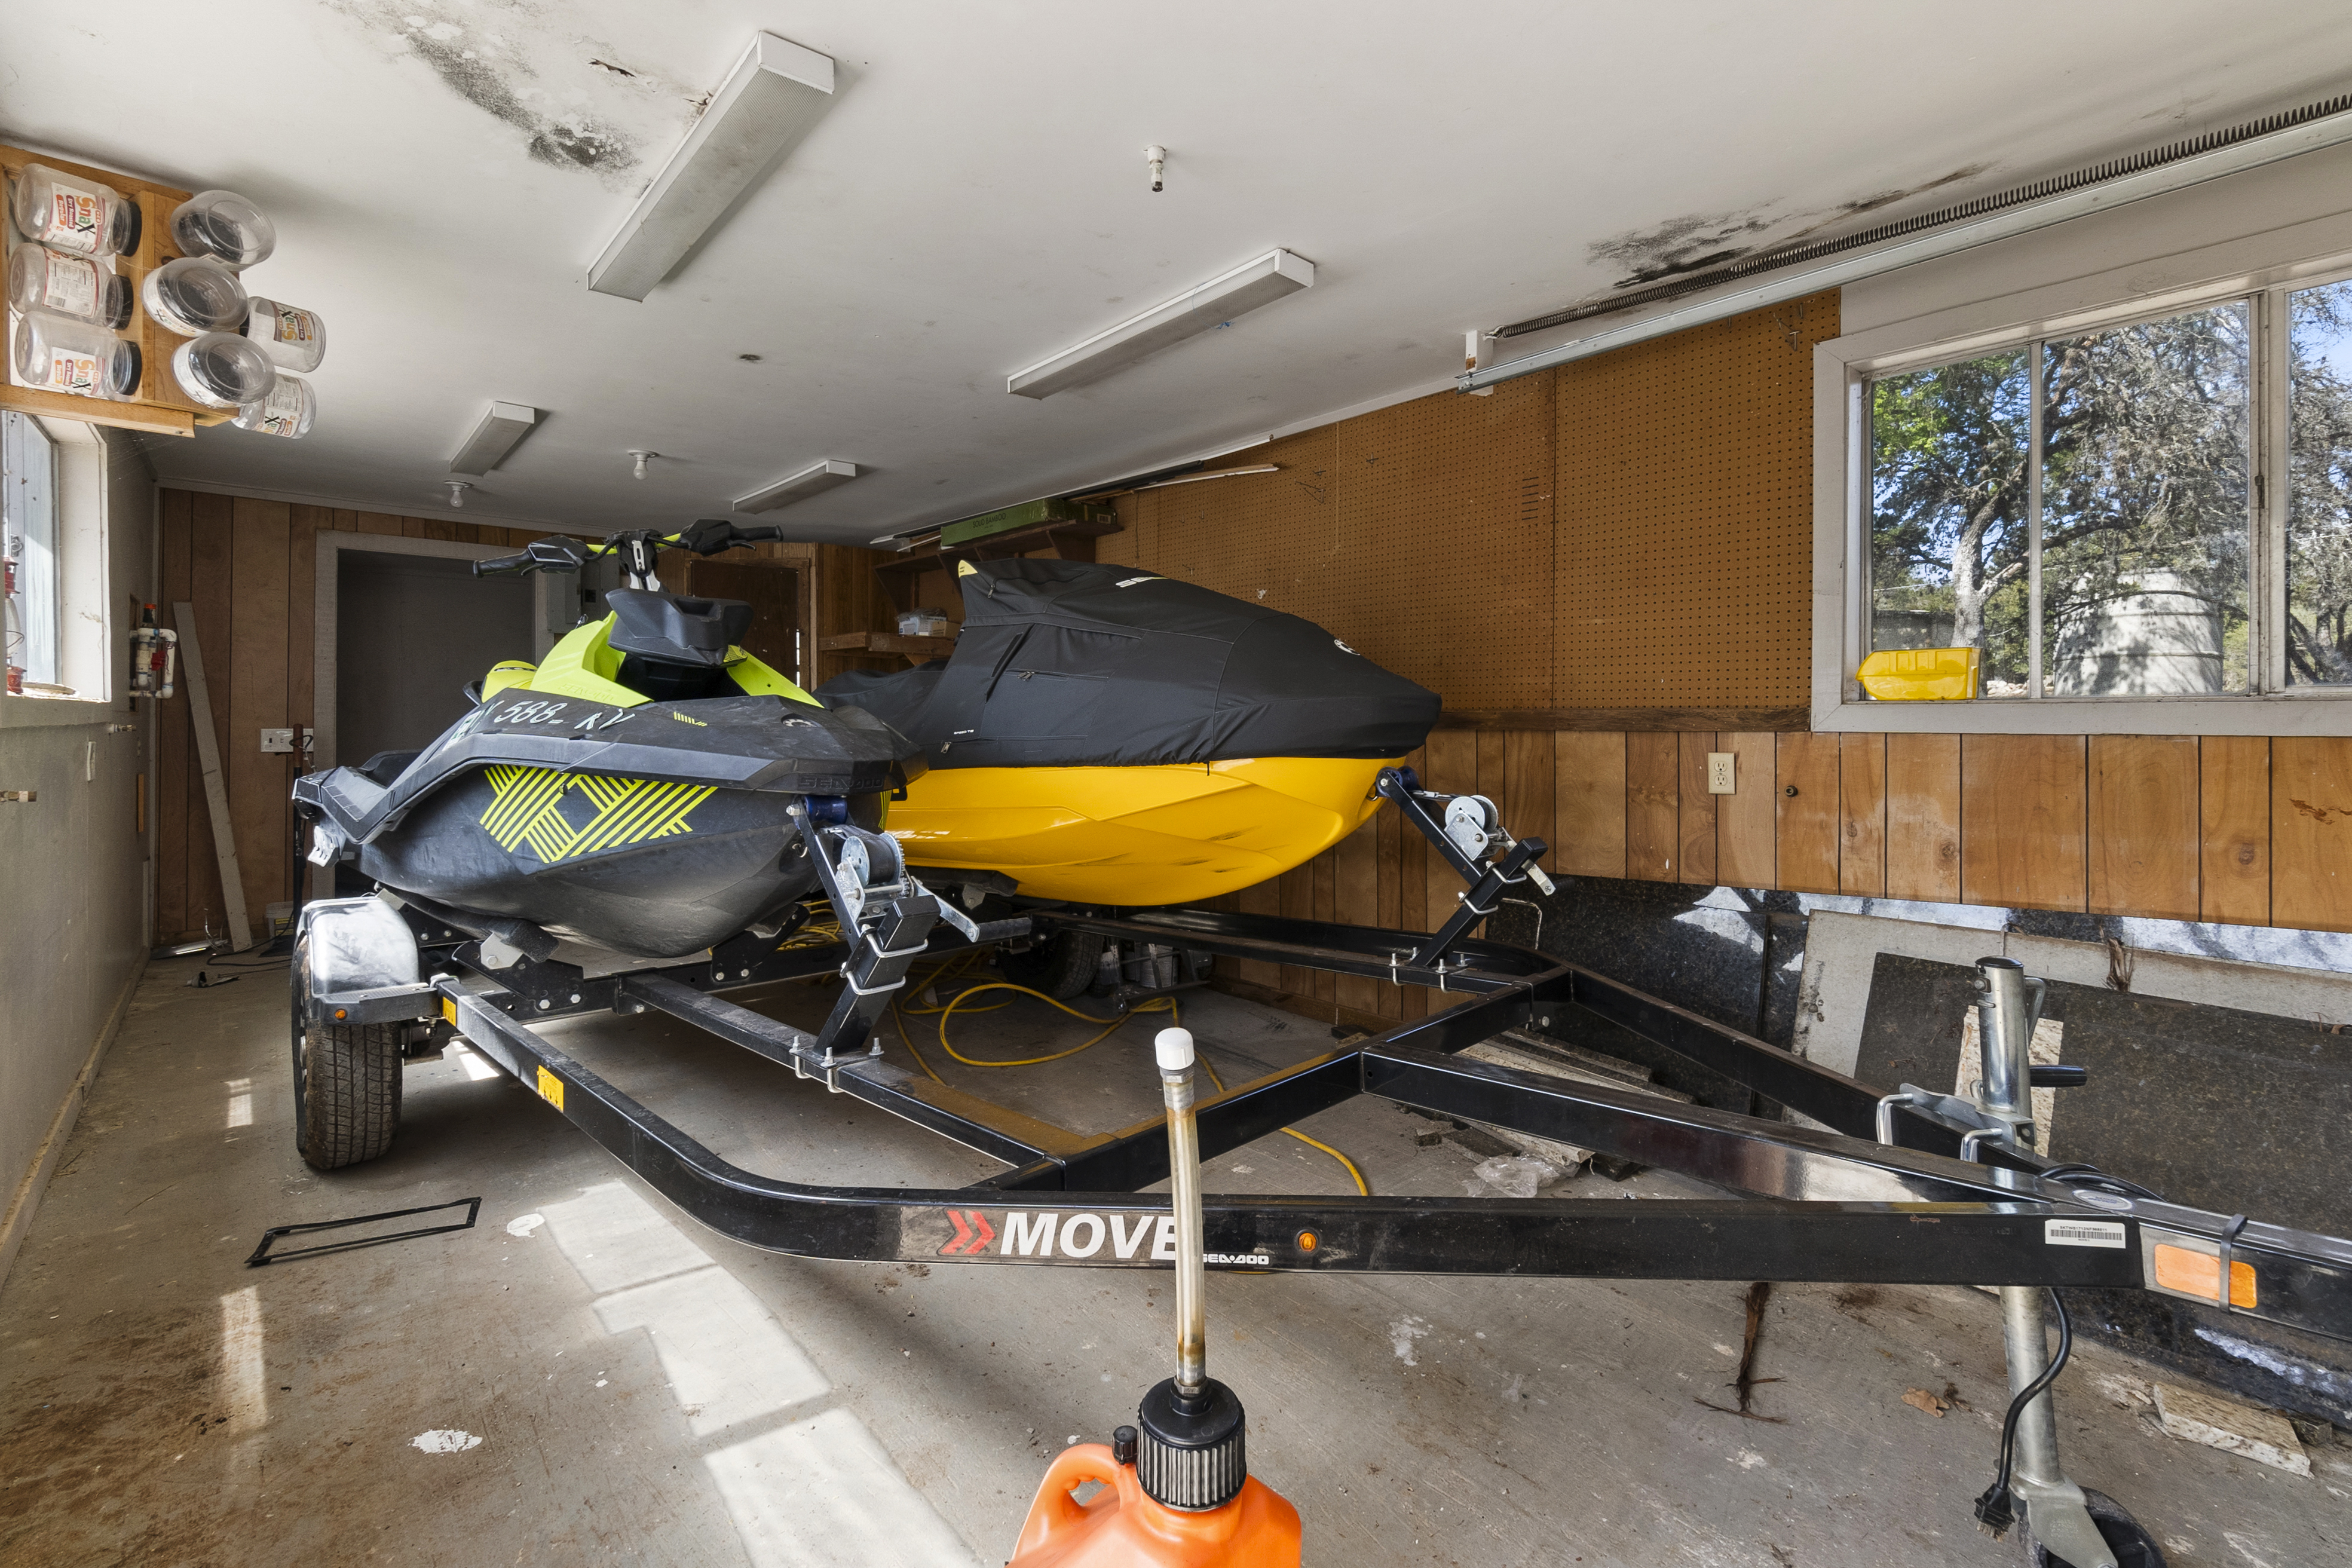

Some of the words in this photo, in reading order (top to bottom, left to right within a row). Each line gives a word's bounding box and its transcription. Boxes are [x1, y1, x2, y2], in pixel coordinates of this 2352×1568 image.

[973, 519, 985, 528] SOLID
[986, 512, 1006, 524] BAMBOO
[1000, 1212, 1175, 1260] MOVE
